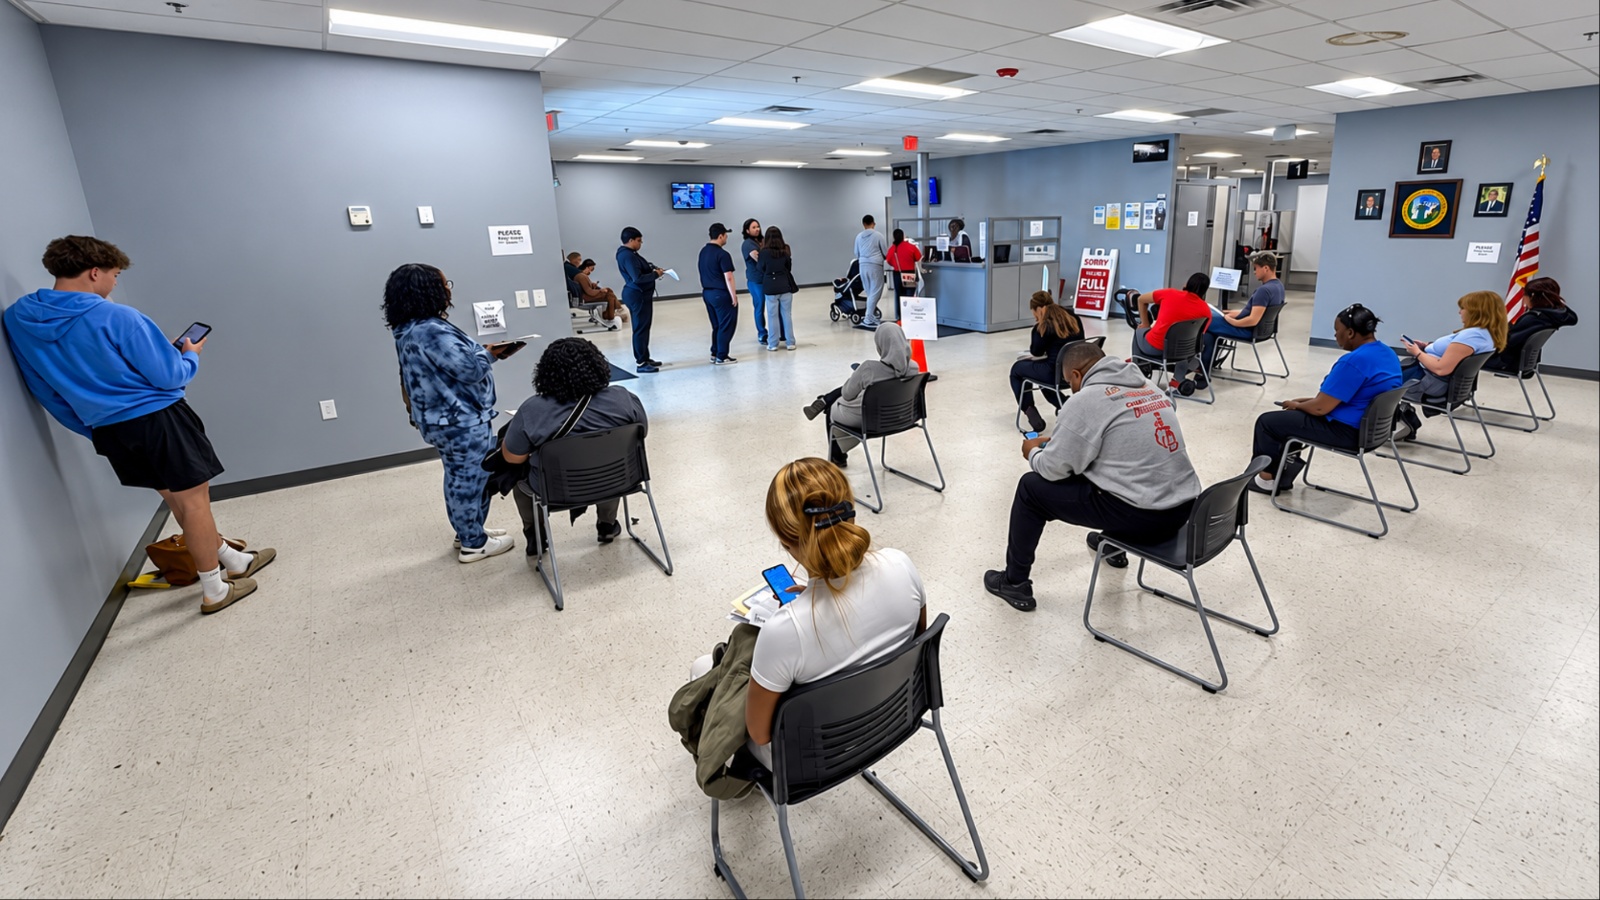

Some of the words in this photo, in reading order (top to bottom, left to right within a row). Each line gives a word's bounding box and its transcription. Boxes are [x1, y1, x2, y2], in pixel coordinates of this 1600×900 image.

[1295, 164, 1301, 176] 1
[1084, 258, 1109, 266] SORRY
[1080, 278, 1105, 290] FULL
